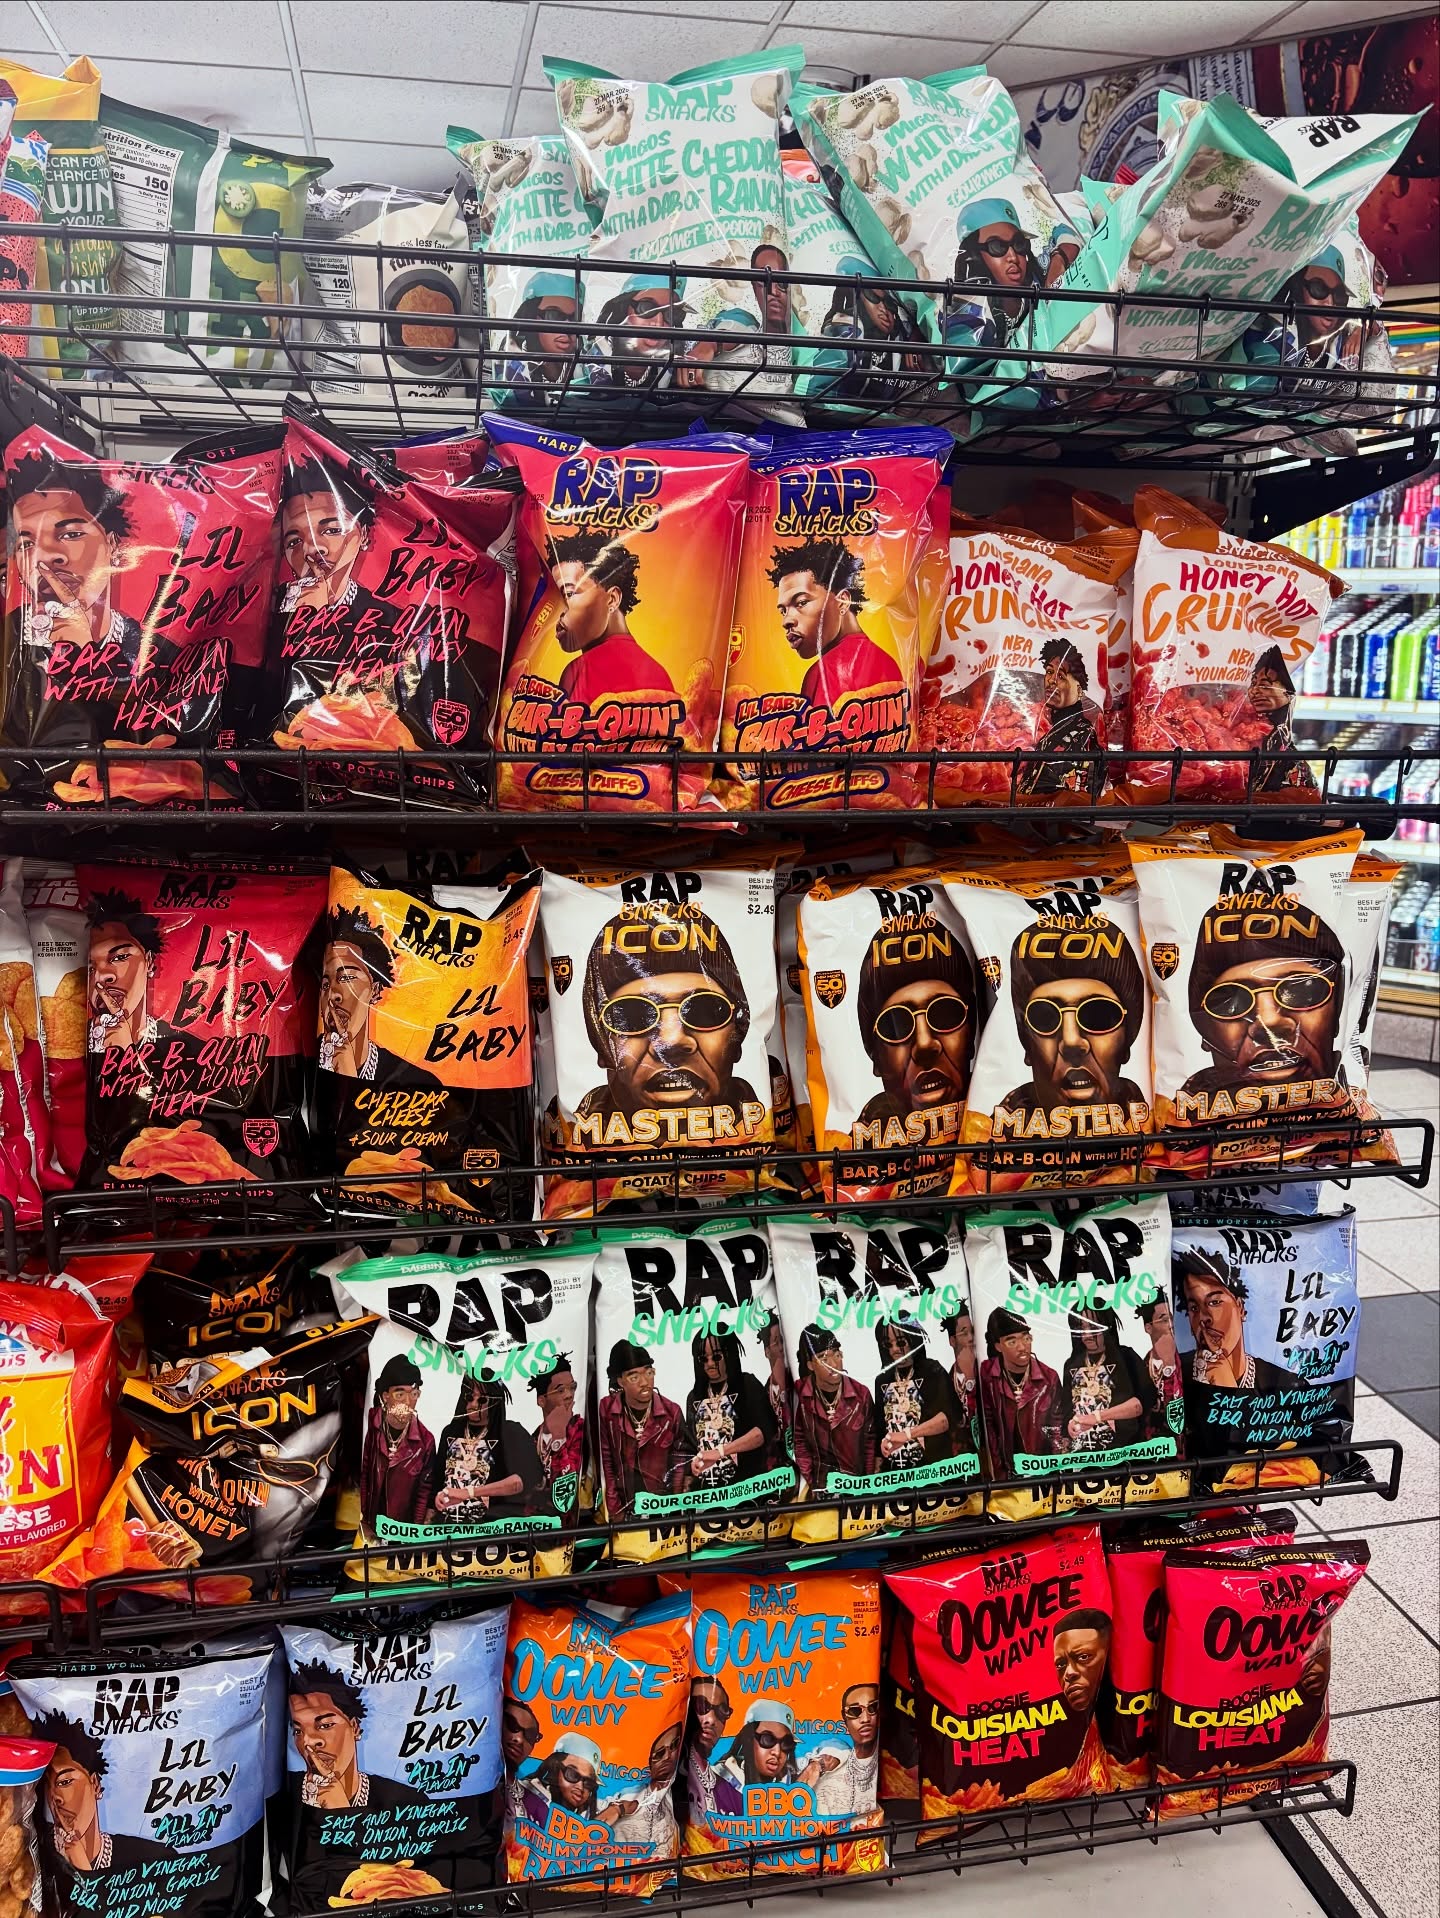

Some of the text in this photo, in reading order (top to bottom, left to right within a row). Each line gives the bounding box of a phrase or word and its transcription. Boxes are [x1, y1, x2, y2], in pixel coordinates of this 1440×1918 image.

[858, 91, 873, 100] MAR
[645, 104, 737, 123] SNACKS
[1309, 115, 1361, 148] RAP
[99, 168, 109, 180] TO
[144, 175, 169, 191] 150
[49, 181, 115, 215] WIN
[1229, 192, 1245, 203] MAR
[1245, 198, 1261, 207] 2025
[602, 211, 637, 238] WITH
[636, 206, 647, 227] A
[647, 192, 683, 223] DAB
[685, 188, 704, 211] OF
[416, 238, 432, 248] less
[333, 278, 349, 289] 120
[206, 447, 238, 459] OFF
[552, 455, 661, 506] RAP
[778, 468, 876, 514] RAP
[774, 507, 878, 536] SNACKS
[171, 512, 245, 569] LIL
[374, 546, 488, 599] BABY
[142, 573, 260, 631] BABY
[1180, 562, 1318, 621] HONEY HOT
[1003, 634, 1033, 653] NBA
[113, 697, 192, 732] HEAT
[435, 708, 466, 726] 50
[738, 696, 806, 724] LIL BABY
[413, 775, 456, 790] CHIPS
[1289, 840, 1347, 859] SUCCESS
[159, 874, 236, 901] RAP
[620, 872, 702, 905] RAP
[1219, 863, 1297, 896] RAP
[153, 895, 230, 909] SNACKS
[619, 903, 702, 921] SNACKS
[747, 903, 775, 915] $2.49
[870, 884, 933, 920] RAP
[1025, 892, 1102, 918] RAP
[1216, 893, 1299, 911] SNACKS
[400, 904, 482, 954] RAP
[881, 911, 936, 934] SNACKS
[1204, 914, 1319, 944] ICON
[193, 925, 252, 971] LIL
[393, 937, 477, 968] SNACKS
[602, 925, 719, 955] ICON
[872, 930, 951, 967] ICON
[1018, 932, 1125, 959] ICON
[1153, 952, 1176, 963] 50
[817, 979, 843, 991] 50
[172, 980, 286, 1027] BABY
[447, 984, 502, 1018] LIL
[425, 1022, 526, 1061] BABY
[100, 1063, 268, 1098] WITH MY HONEY
[149, 1088, 222, 1119] HEAT
[355, 1089, 449, 1110] CHEDDAR
[1176, 1078, 1337, 1121] MASTER
[368, 1108, 439, 1127] CHEESE
[572, 1101, 765, 1146] MASTER P
[1272, 1114, 1313, 1124] WITH MY
[684, 1172, 727, 1184] CHIPS
[1179, 1218, 1209, 1226] HARD
[810, 1228, 949, 1304] RAP
[1003, 1217, 1143, 1289] RAP
[1229, 1247, 1298, 1266] SNACKS
[624, 1234, 771, 1320] RAP
[1285, 1268, 1330, 1304] LIL
[628, 1297, 770, 1347] SNACKS
[1276, 1306, 1356, 1344] BABY
[1208, 1386, 1332, 1410] SALT AND VINEGAR,
[1246, 1423, 1313, 1443] AND MORE
[1022, 1444, 1170, 1471] SOUR CREAM RANCH
[834, 1459, 976, 1491] SOUR CREAM RANCH
[641, 1473, 791, 1511] SOUR CREAM RANCH
[1132, 1488, 1160, 1496] CHIPS
[161, 1485, 247, 1541] HONEY
[13, 1519, 67, 1544] FLAVORED
[381, 1521, 553, 1538] SOUR CREAM RANCH
[1143, 1524, 1267, 1547] APPRECIATE THE GOOD TIMES
[980, 1553, 1027, 1589] RAP
[1059, 1556, 1084, 1571] $2.49
[1259, 1552, 1336, 1563] THE GOOD TIMES
[750, 1582, 797, 1609] RAP
[1258, 1575, 1307, 1602] RAP
[440, 1607, 463, 1619] OFF
[748, 1603, 799, 1617] SNACKS
[937, 1573, 1083, 1664] OOWEE
[1262, 1599, 1309, 1612] SNACKS
[485, 1626, 500, 1636] BEST
[694, 1609, 852, 1675] OOWEE
[854, 1624, 880, 1637] $2.49
[567, 1643, 621, 1656] SNACKS
[984, 1626, 1049, 1676] WAVY
[60, 1664, 97, 1672] HARD
[348, 1663, 432, 1686] SNACKS
[511, 1638, 671, 1702] OOWEE
[739, 1660, 812, 1694] WAVY
[94, 1676, 180, 1722] RAP
[414, 1684, 462, 1716] LIL
[1174, 1688, 1304, 1729] LOUISIANA
[89, 1710, 178, 1737] SNACKS
[551, 1703, 627, 1726] WAVY
[794, 1718, 847, 1735] MIGOS
[931, 1700, 1067, 1742] LOUISIANA
[398, 1717, 488, 1758] BABY
[1199, 1715, 1286, 1751] HEAT
[160, 1739, 211, 1772] LIL
[953, 1729, 1045, 1766] HEAT
[145, 1764, 237, 1814] BABY
[417, 1778, 457, 1793] FLAVOR
[748, 1787, 813, 1816] BBQ
[519, 1821, 650, 1858] WITH MY HONEY
[548, 1808, 609, 1845] BBQ
[711, 1818, 848, 1837] WITH MY HONEY
[360, 1839, 437, 1860] AND MORE
